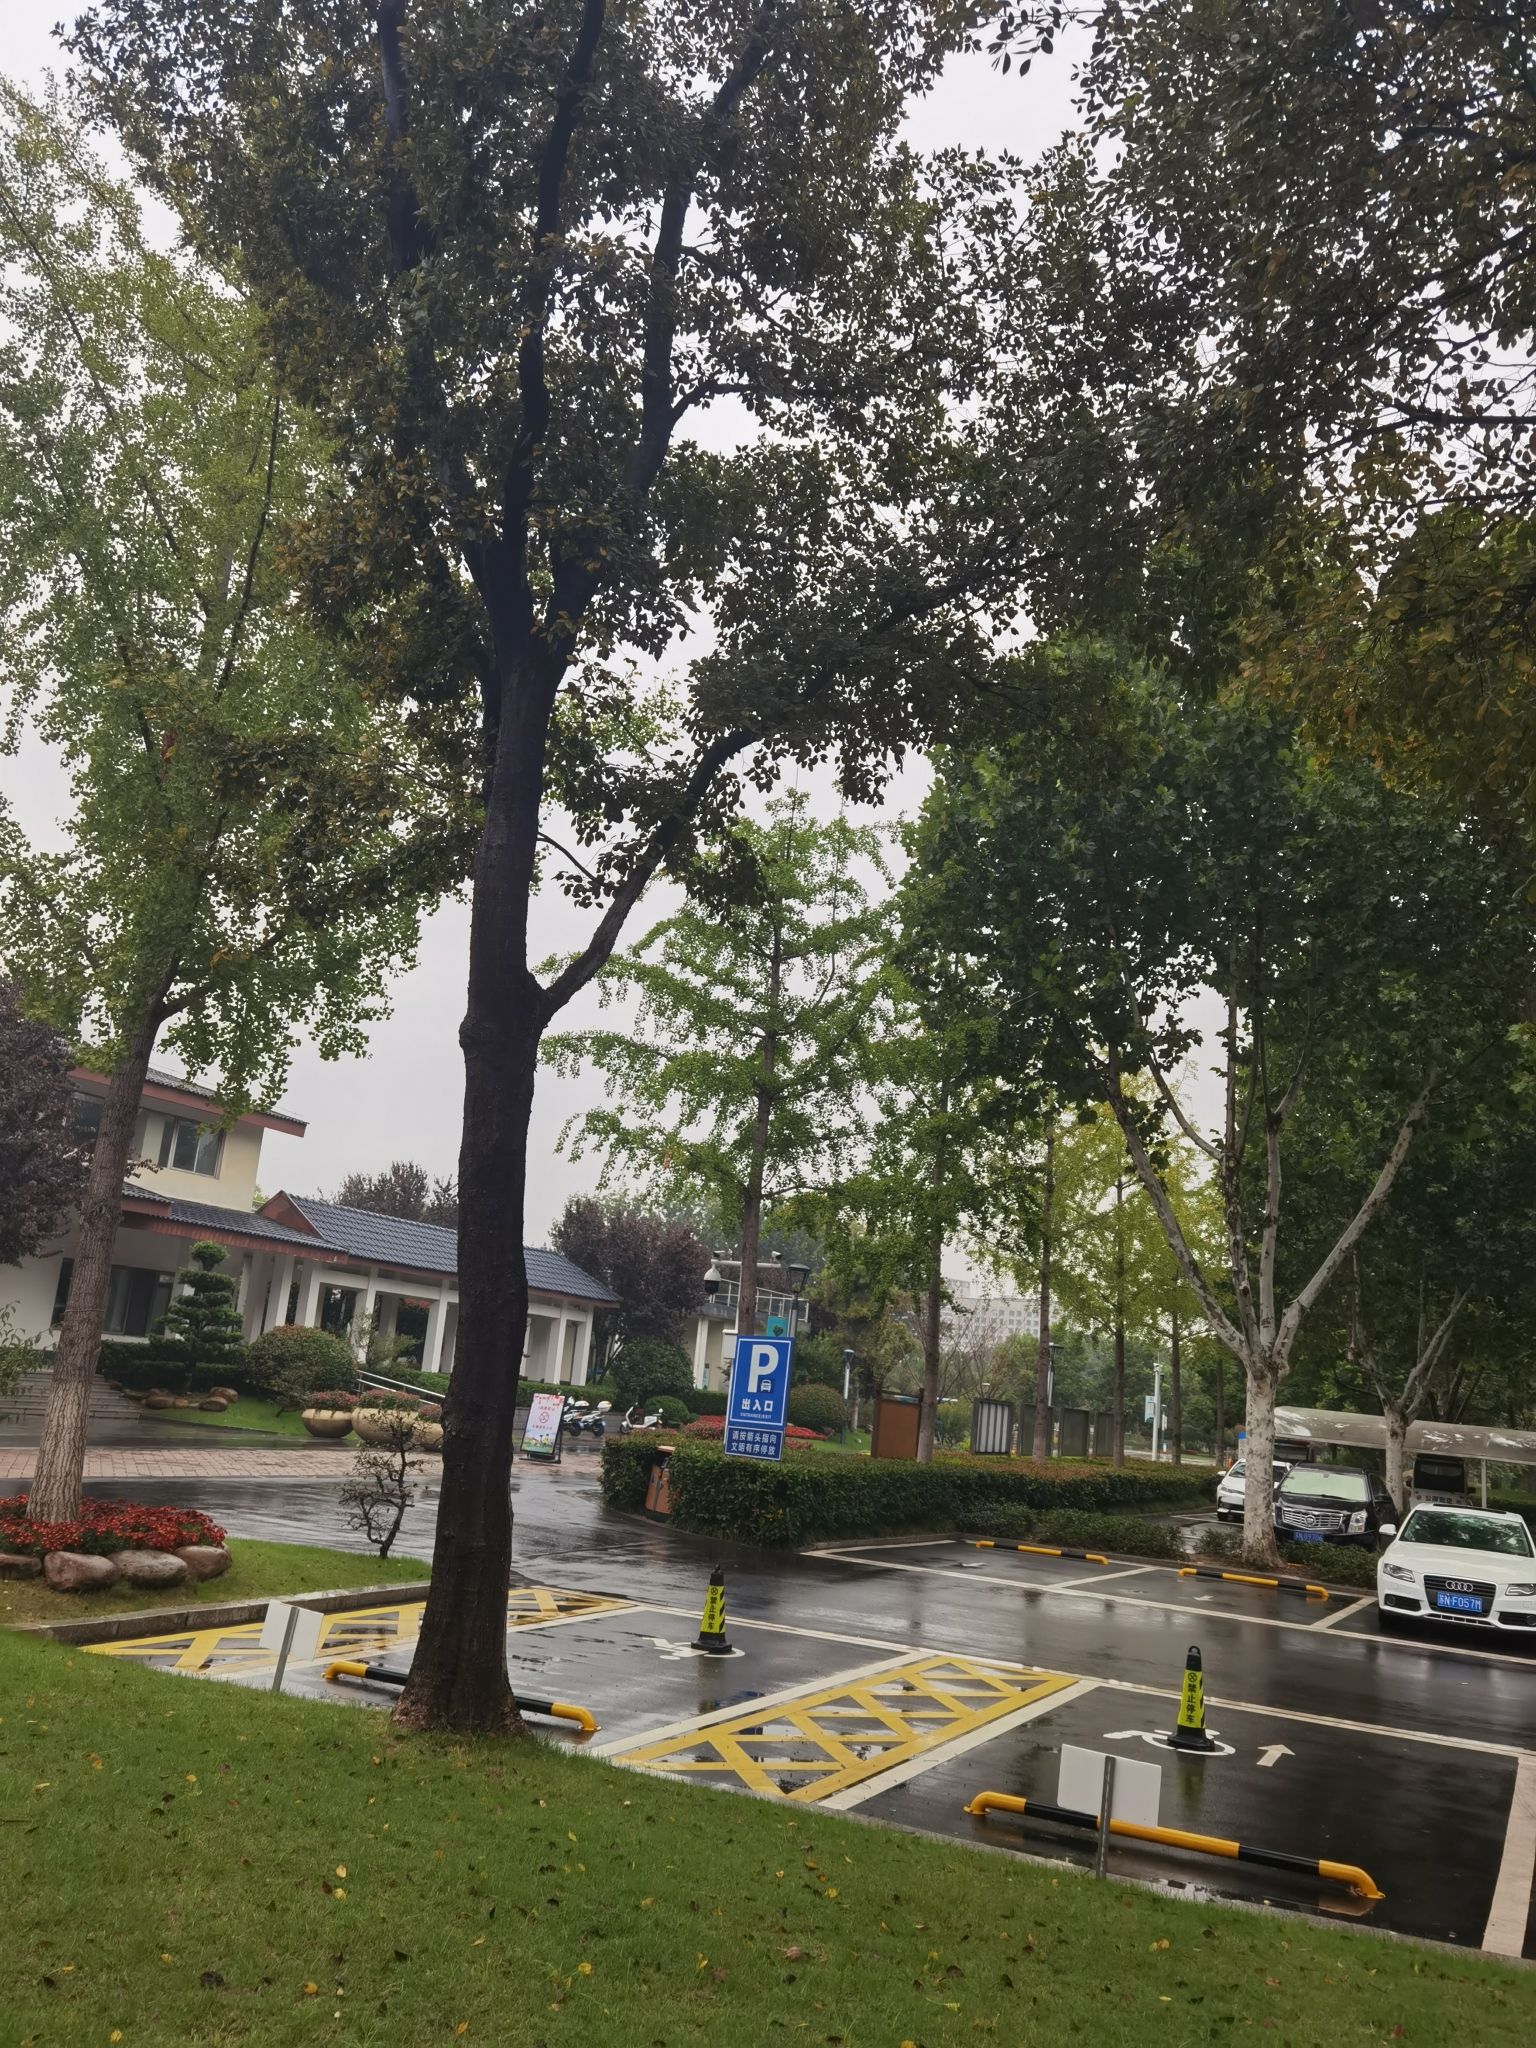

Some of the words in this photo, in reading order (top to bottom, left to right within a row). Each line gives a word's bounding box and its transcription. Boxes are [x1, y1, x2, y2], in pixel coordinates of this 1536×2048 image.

[747, 1344, 779, 1393] P
[741, 1398, 774, 1412] 出入口
[730, 1442, 776, 1456] 文明有序停放
[732, 1430, 777, 1444] 请按箭头指向
[707, 1596, 717, 1630] 禁止停车
[1186, 1683, 1197, 1724] 禁止停车
